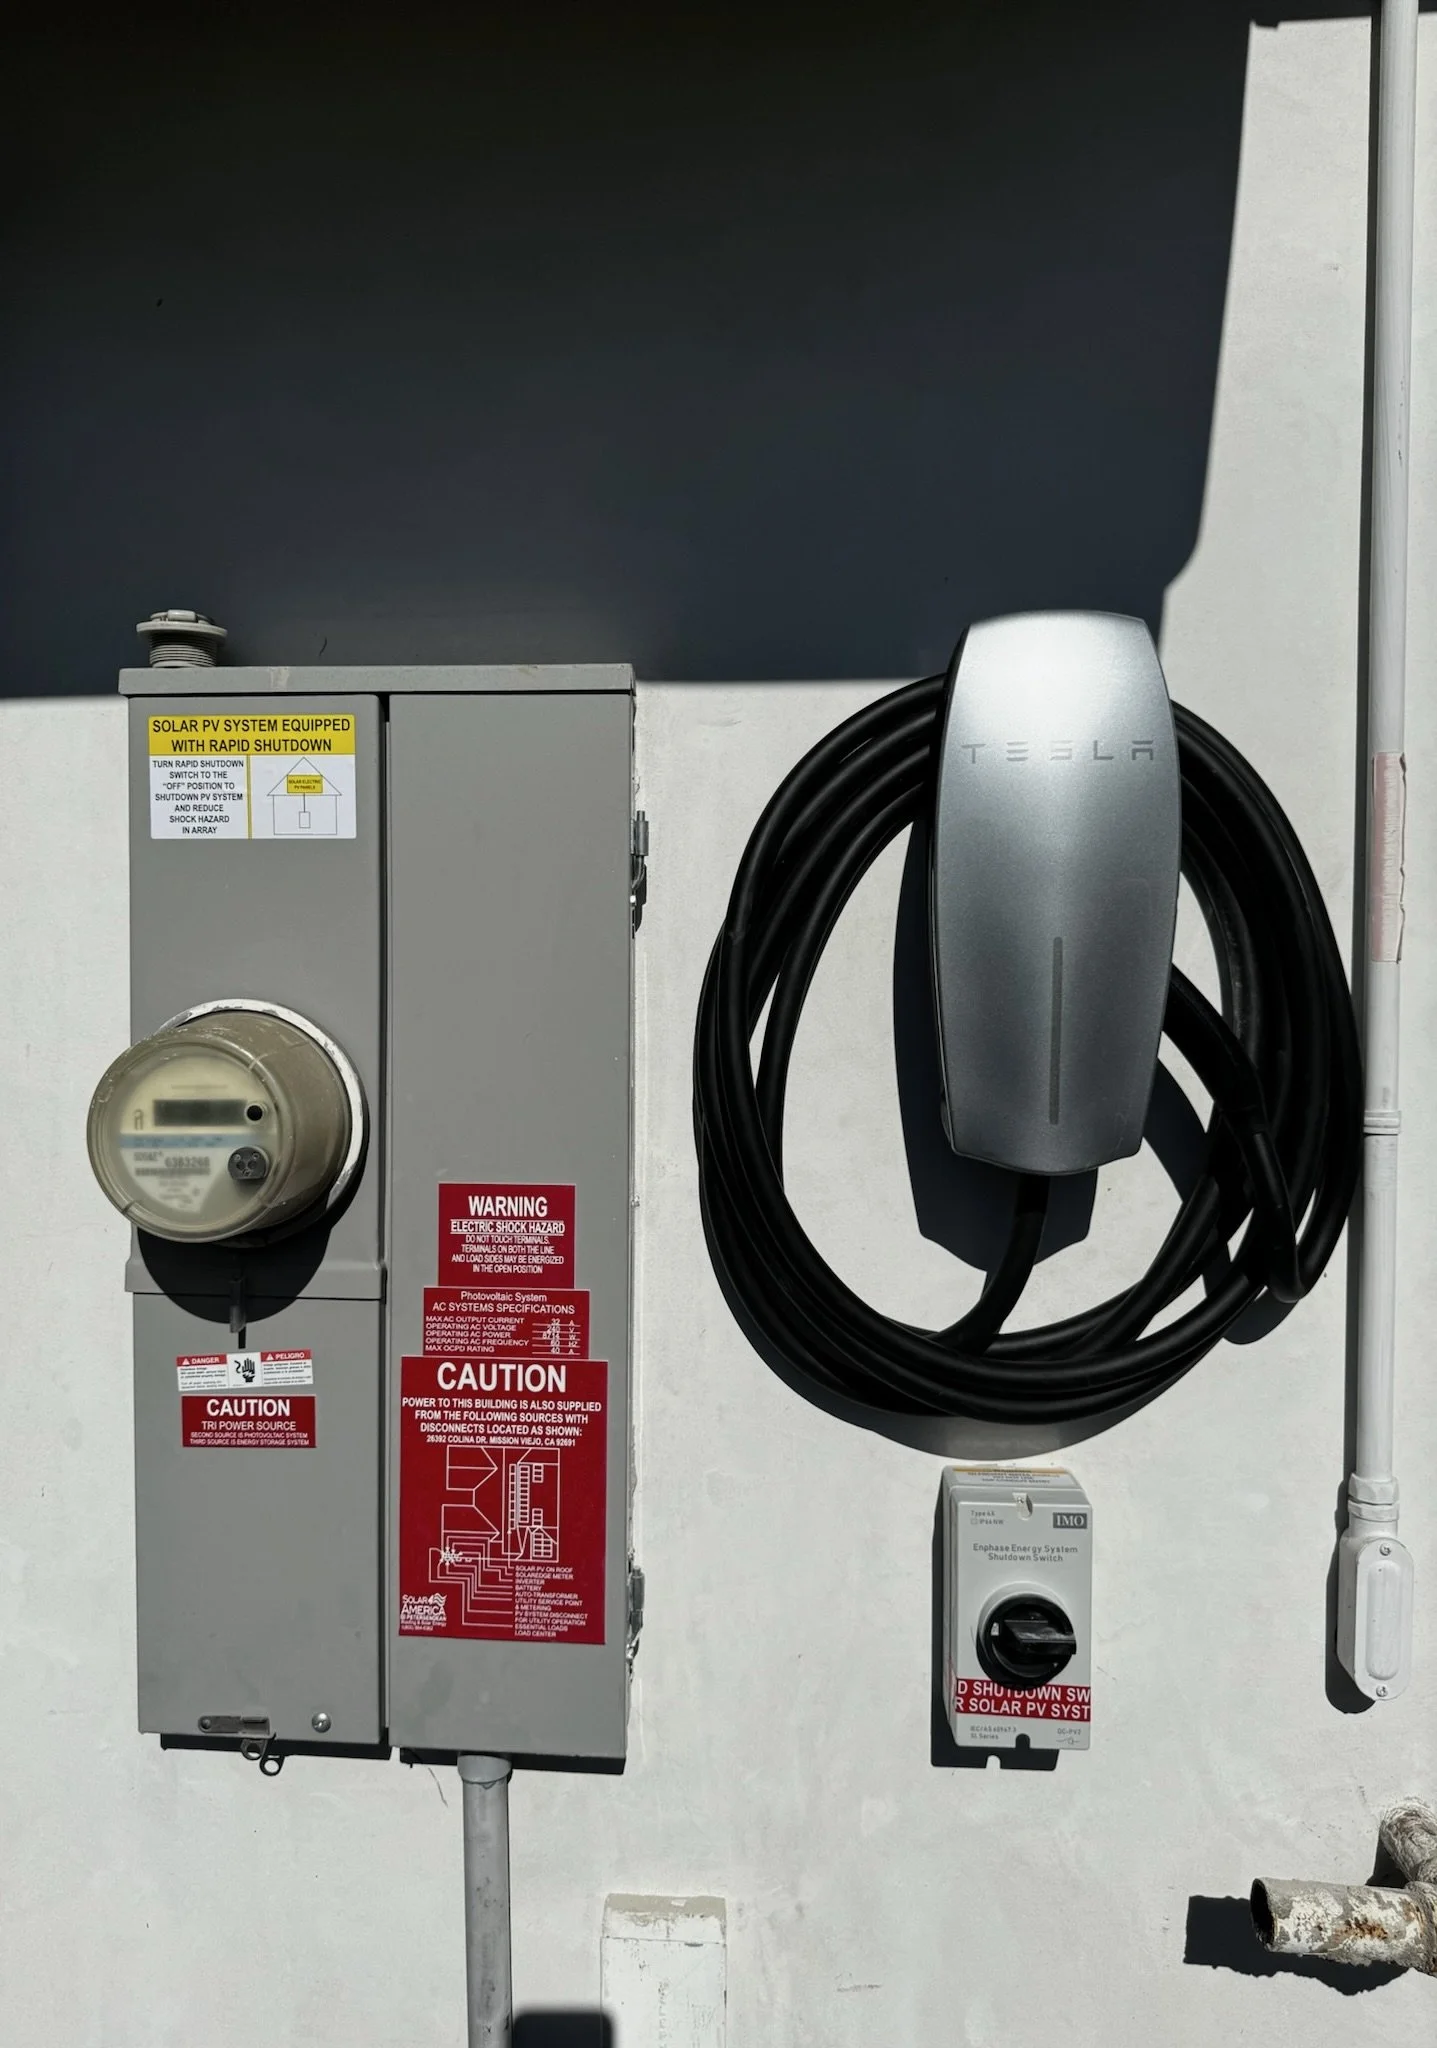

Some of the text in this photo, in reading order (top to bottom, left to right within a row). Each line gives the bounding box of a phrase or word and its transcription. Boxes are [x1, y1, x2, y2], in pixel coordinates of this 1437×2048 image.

[153, 718, 350, 732] SOLAR PV SYSTEM EQUIPPED
[172, 739, 332, 752] WITH RAPID SHUTDOWN
[962, 740, 1153, 764] TESLA
[468, 1196, 548, 1217] WARNING
[451, 1221, 565, 1234] ELECTRIC SHOCK HAZARD
[477, 1235, 489, 1243] NOT
[514, 1236, 550, 1244] TERMINALS.
[462, 1244, 554, 1254] TERMINALS ON BOTH THE LINE
[452, 1254, 564, 1264] AND LOAD SIDES MAY BE ENERGIZED
[473, 1264, 543, 1274] IN THE OPEN POSITION
[461, 1291, 547, 1303] Photovoltaic System
[432, 1302, 575, 1314] AC SYSTEMS SPECIFICATIONS
[437, 1362, 566, 1392] CAUTION
[207, 1399, 290, 1416] CAUTION
[402, 1397, 601, 1411] POWER TO THIS BUILDING IS ALSO SUPPLIED
[415, 1410, 588, 1424] FROM THE FOLLOWING SOURCES WITH
[202, 1421, 296, 1430] TRI POWER SOURCE
[421, 1423, 582, 1436] DISCONNECTS LOCATED AS SHOWN:
[520, 1437, 543, 1446] VIEJO,
[1057, 1515, 1084, 1526] IMO
[973, 1543, 1078, 1554] Enphase Energy System
[988, 1553, 1063, 1562] Shutdown Switch
[401, 1603, 445, 1615] AMERICA
[969, 1698, 1021, 1715] SOLAR
[1026, 1702, 1046, 1716] PV
[1051, 1703, 1090, 1719] SYST
